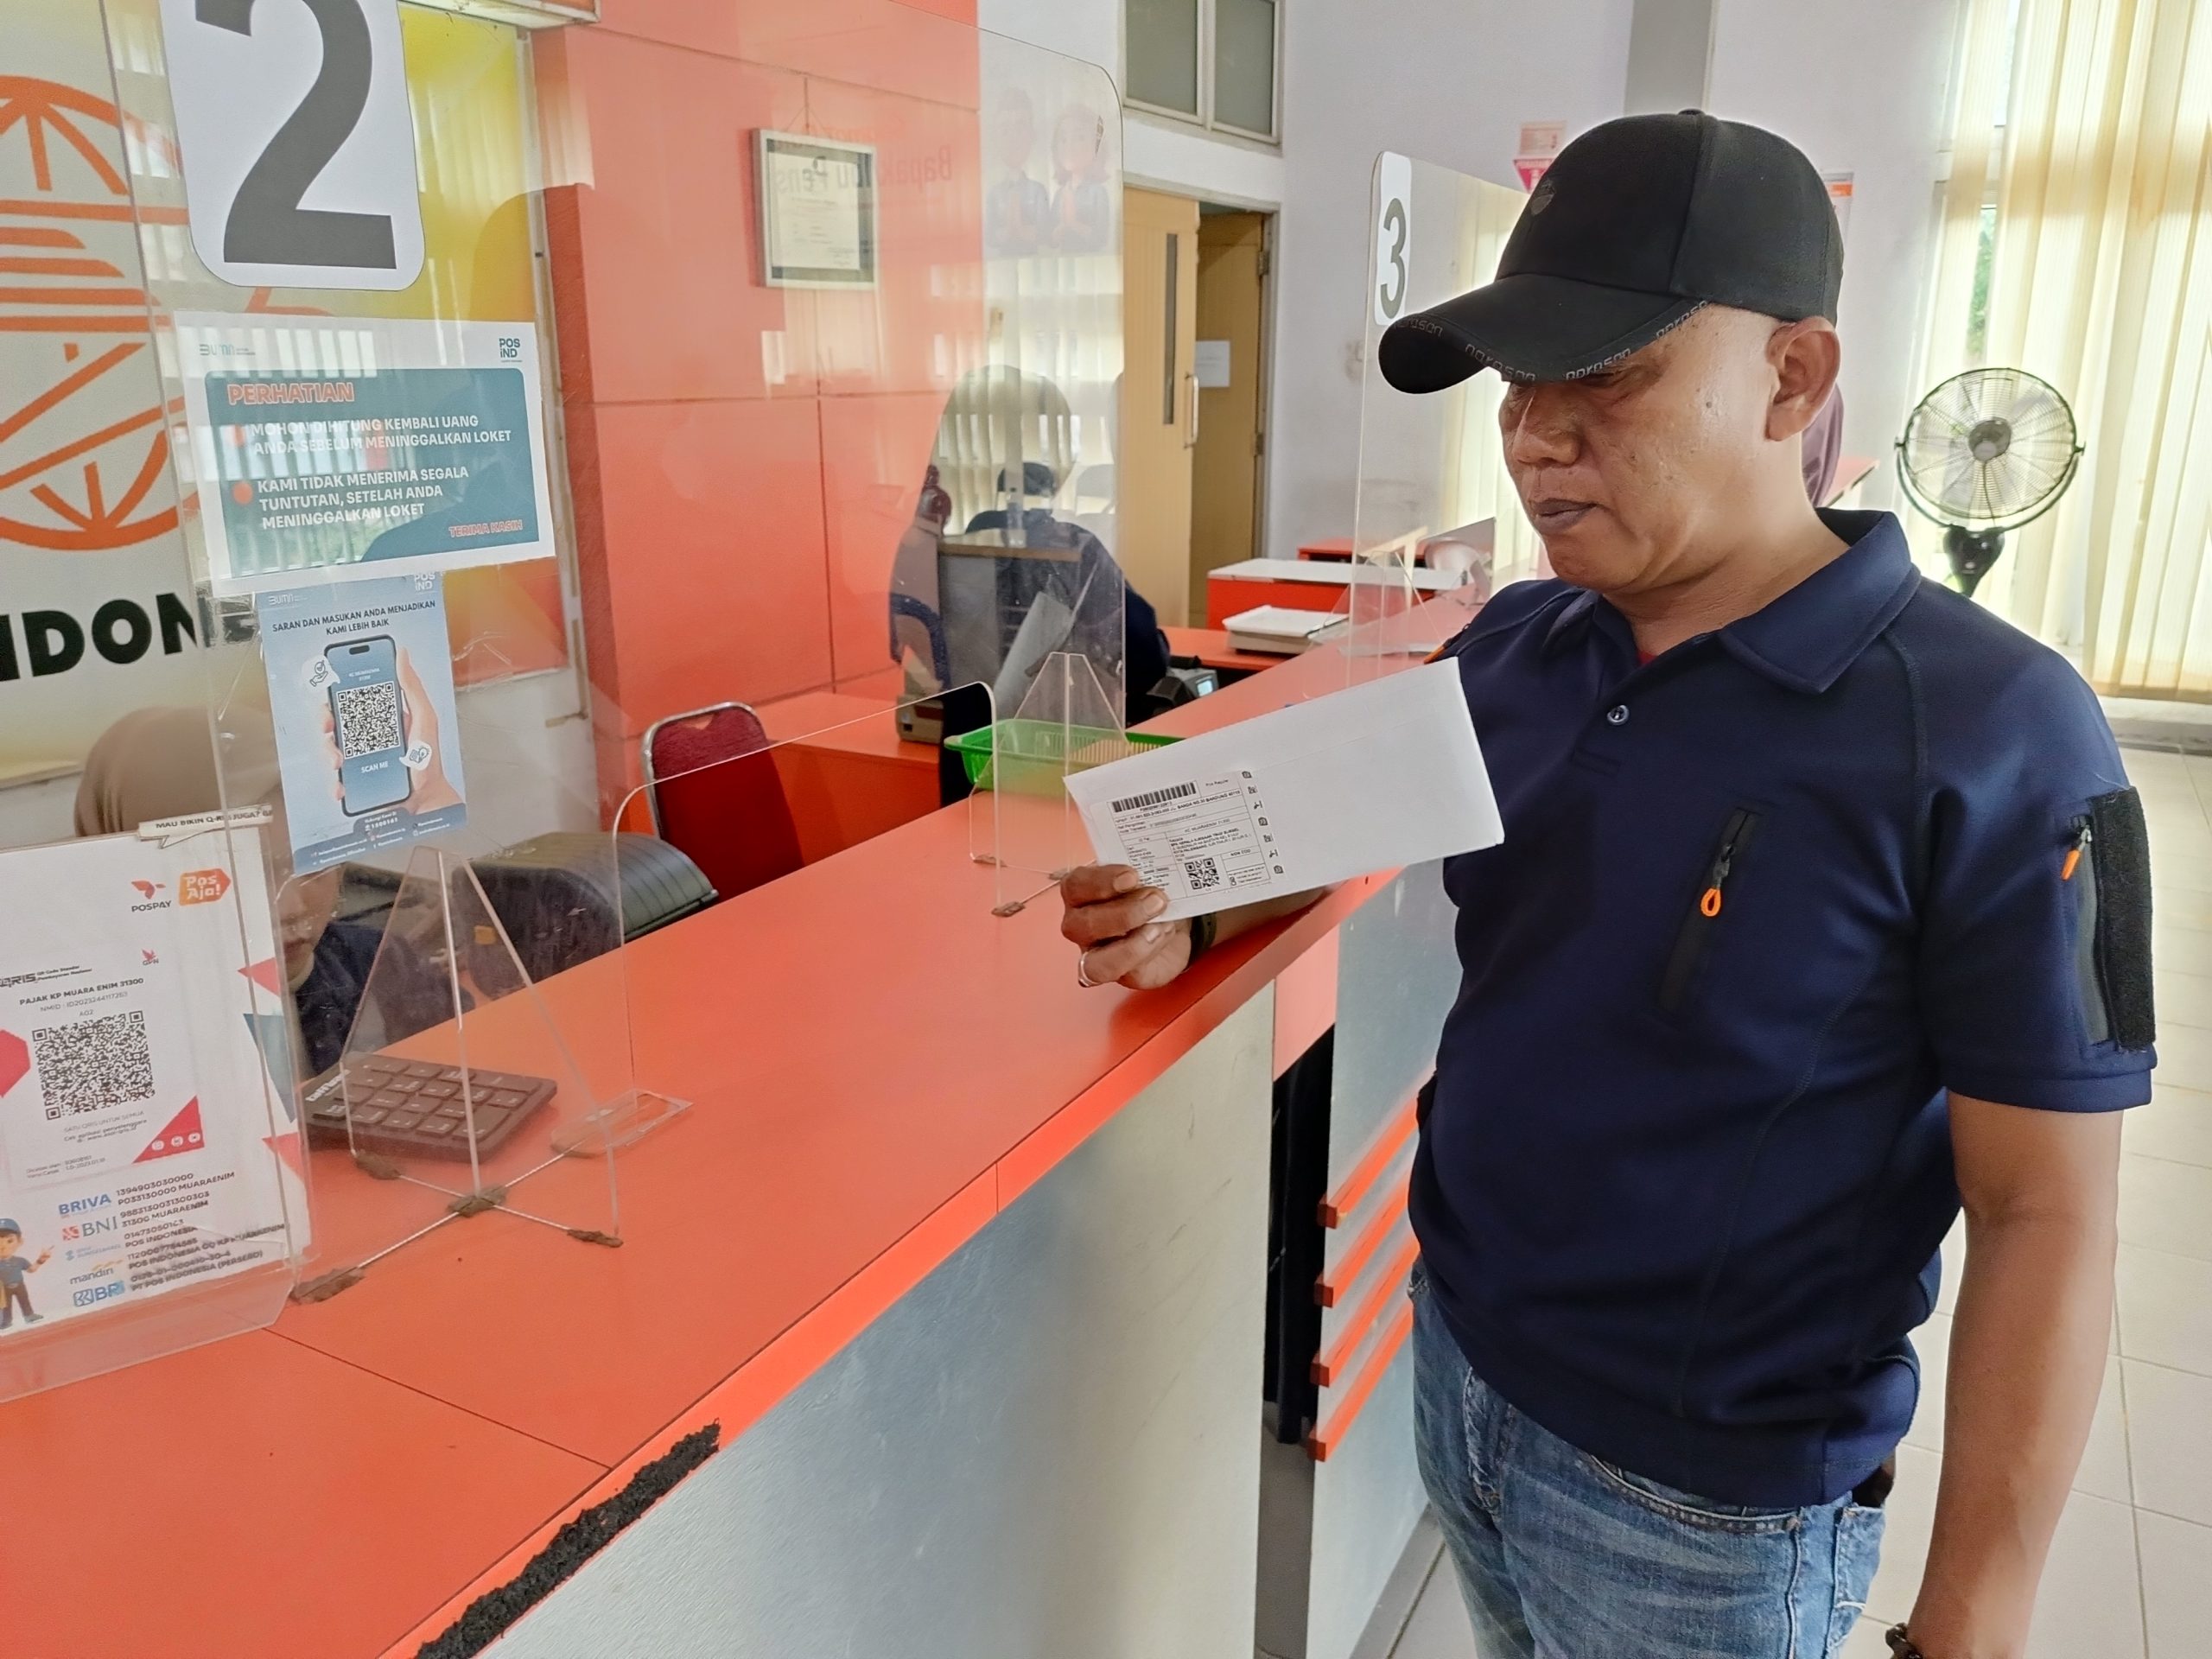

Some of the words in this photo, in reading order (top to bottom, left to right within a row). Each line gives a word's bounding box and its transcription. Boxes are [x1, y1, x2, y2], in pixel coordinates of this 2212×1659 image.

[195, 0, 397, 270] 2
[1380, 198, 1407, 319] 3
[499, 338, 520, 348] POS
[226, 381, 355, 405] PERHATIAN
[251, 421, 310, 436] MOHON
[311, 418, 383, 435] DIHITUNG
[385, 416, 439, 430] KEMBALI
[442, 415, 479, 428] UANG
[253, 442, 297, 454] ANDA
[302, 436, 363, 452] SEBELUM
[365, 432, 471, 448] MENINGGALKAN
[474, 430, 512, 443] LOKET
[258, 478, 298, 493] KAMI
[301, 475, 344, 490] TIDAK
[347, 469, 418, 486] MENERIMA
[421, 467, 469, 480] SEGALA
[259, 493, 344, 512] TUNTUTAN,
[346, 487, 403, 504] SETELAH
[406, 485, 443, 499] ANDA
[263, 507, 383, 530] MENINGGALKAN
[385, 503, 424, 518] LOKET
[448, 522, 491, 537] TERIMA
[491, 519, 523, 534] KASIH
[414, 573, 435, 582] POS
[272, 620, 301, 632] SARAN
[302, 618, 321, 628] DAN
[322, 611, 362, 625] MASUKAN
[364, 607, 386, 618] ANDA
[387, 601, 435, 614] MENJADIKAN
[326, 626, 346, 635] KAMI
[348, 622, 370, 632] LEBIH
[371, 619, 390, 628] BAIK
[361, 763, 378, 773] SCAN
[186, 875, 217, 887] Pos
[187, 884, 221, 900] Aja!
[131, 900, 172, 913] POSPAY
[19, 994, 48, 1006] PAJAK
[63, 987, 95, 998] MUARA
[97, 982, 118, 991] ENIM
[120, 977, 144, 987] 31300
[178, 1172, 235, 1192] MUARAENIM
[59, 1193, 111, 1215] BRIVA
[151, 1200, 209, 1219] MUARAENIM
[82, 1216, 118, 1237] BNI
[125, 1239, 144, 1249] POS
[146, 1227, 199, 1244] INDONESIA
[149, 1246, 201, 1265] INDONESIA
[70, 1268, 114, 1285] mandiri
[143, 1278, 164, 1289] POS
[165, 1264, 216, 1283] INDONESIA
